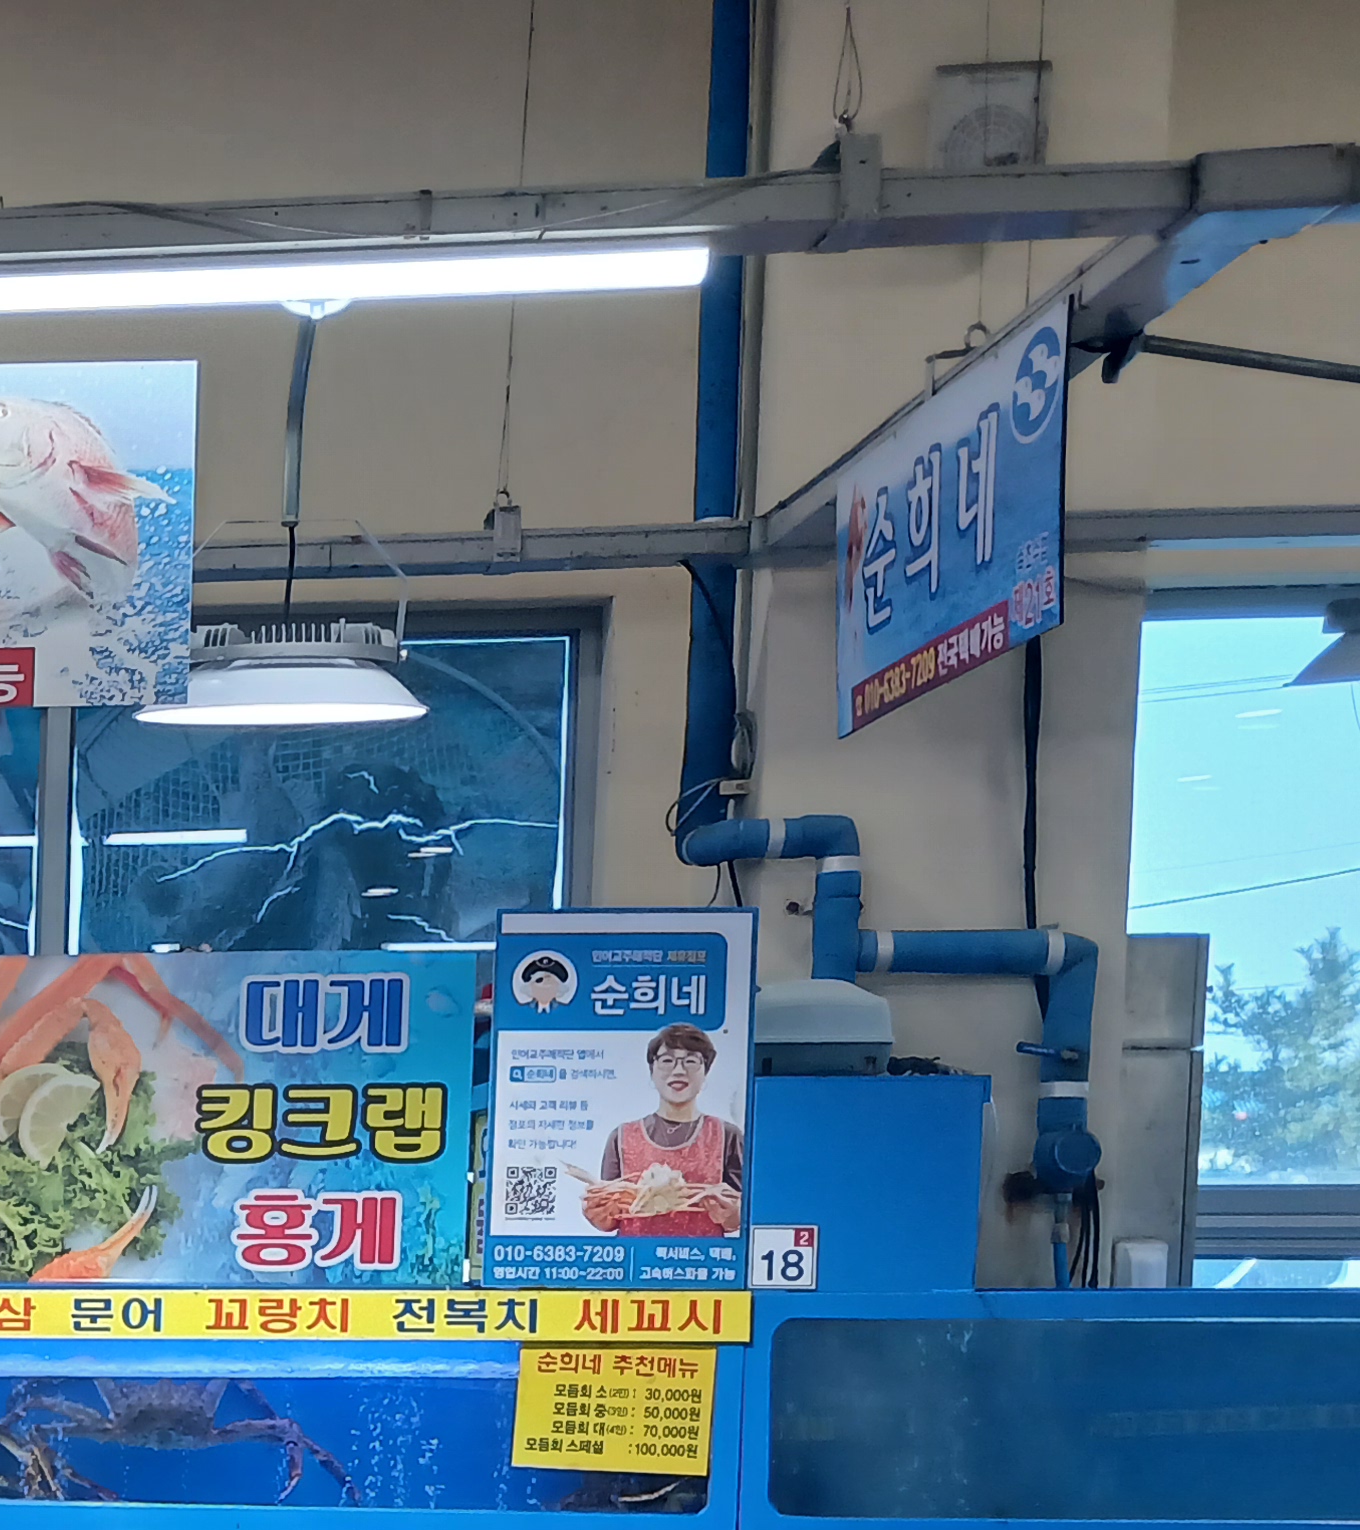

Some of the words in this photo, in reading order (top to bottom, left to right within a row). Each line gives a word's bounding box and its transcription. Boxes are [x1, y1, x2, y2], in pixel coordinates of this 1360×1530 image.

[862, 402, 1000, 636] 순희네
[590, 973, 707, 1016] 순희네
[241, 973, 410, 1054] 대게
[197, 1082, 449, 1164] 킹크랩
[234, 1188, 403, 1272] 홍게
[798, 1231, 810, 1246] 2
[492, 1245, 626, 1263] 010-6383-7209
[760, 1249, 805, 1282] 18
[69, 1298, 164, 1334] 문어
[204, 1298, 350, 1335] 꼬랑치
[392, 1297, 540, 1336] 전복치
[573, 1297, 725, 1337] 세꼬시
[536, 1351, 602, 1375] 순희네
[612, 1354, 700, 1379] 추천메뉴
[644, 1388, 703, 1405] 30,000원
[643, 1406, 702, 1423] 50,000원
[642, 1424, 700, 1441] 70,000원
